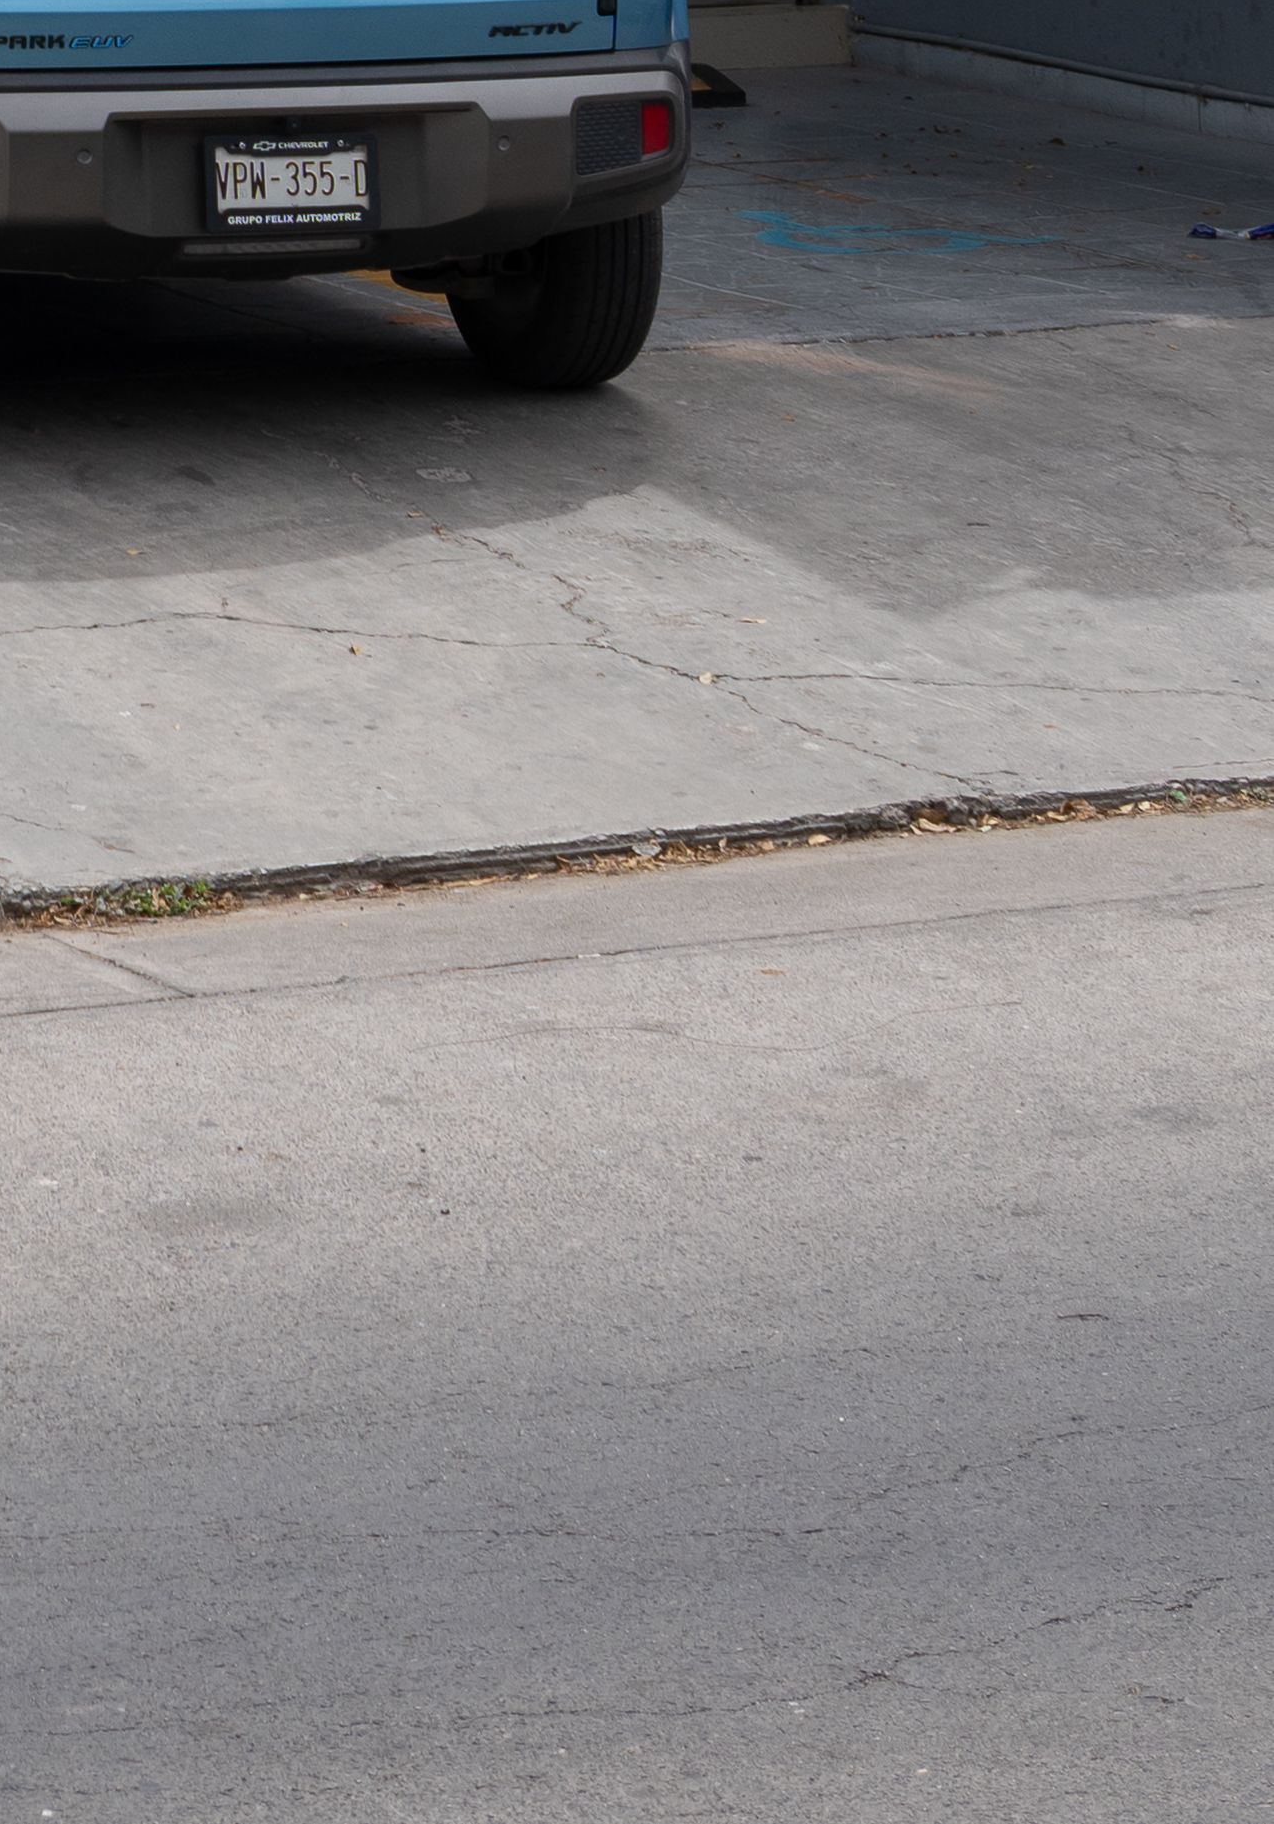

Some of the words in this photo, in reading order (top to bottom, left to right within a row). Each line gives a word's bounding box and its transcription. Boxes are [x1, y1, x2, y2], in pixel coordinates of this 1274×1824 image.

[488, 20, 583, 38] ACTIV
[69, 34, 134, 49] EUV
[278, 141, 329, 149] CHEVROLET
[215, 160, 368, 200] VPW-355-D
[228, 215, 263, 225] GRUPO
[265, 214, 294, 224] FELIX
[296, 212, 362, 223] AUTOMOTRIZ
